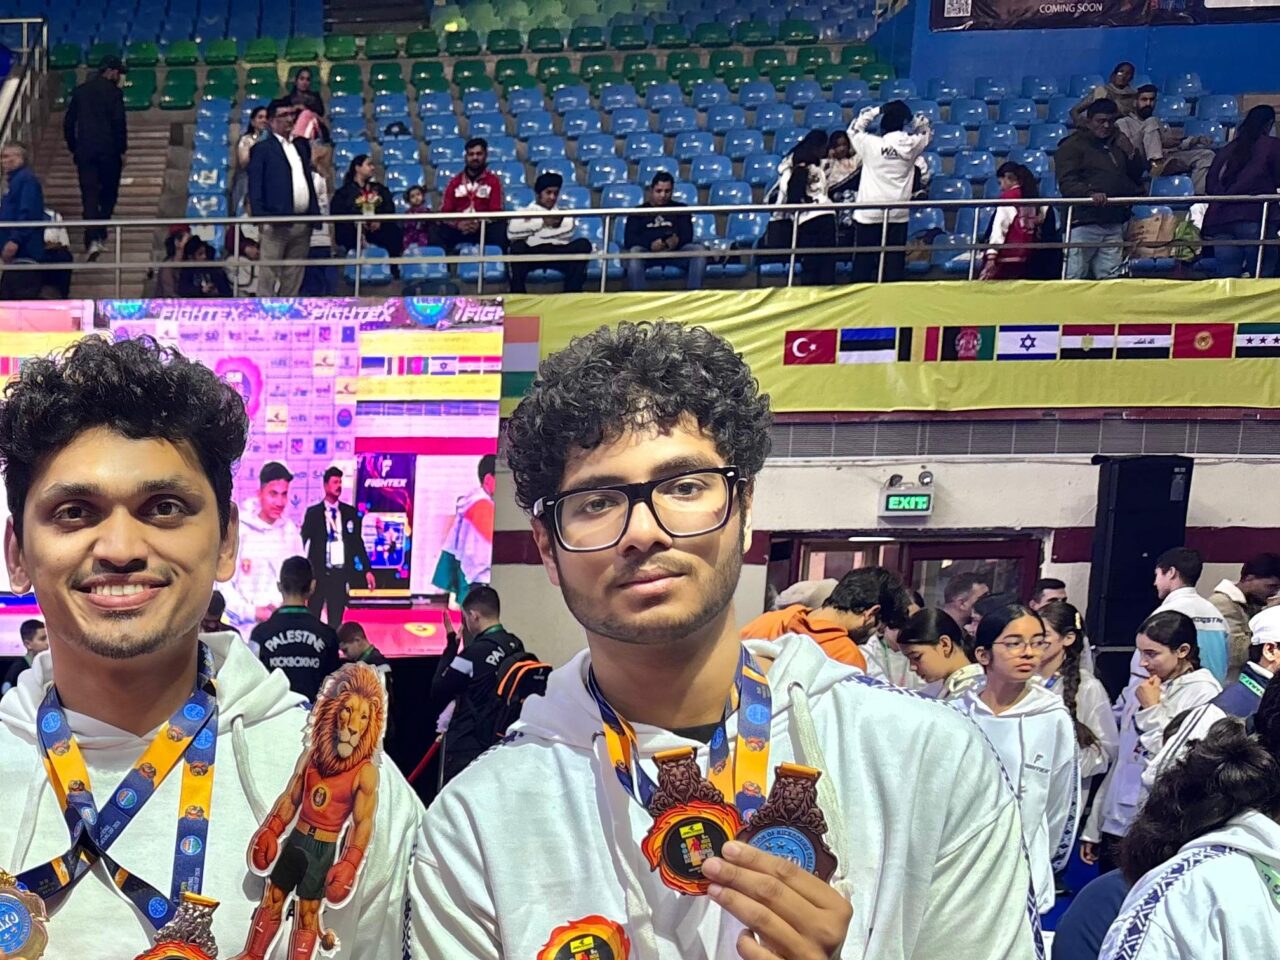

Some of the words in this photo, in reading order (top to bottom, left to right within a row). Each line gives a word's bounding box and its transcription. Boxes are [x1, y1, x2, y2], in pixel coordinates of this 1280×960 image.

[1039, 3, 1076, 13] COMING
[1077, 3, 1103, 12] SOON
[888, 495, 928, 510] EXIT
[264, 629, 326, 653] PALESTINE
